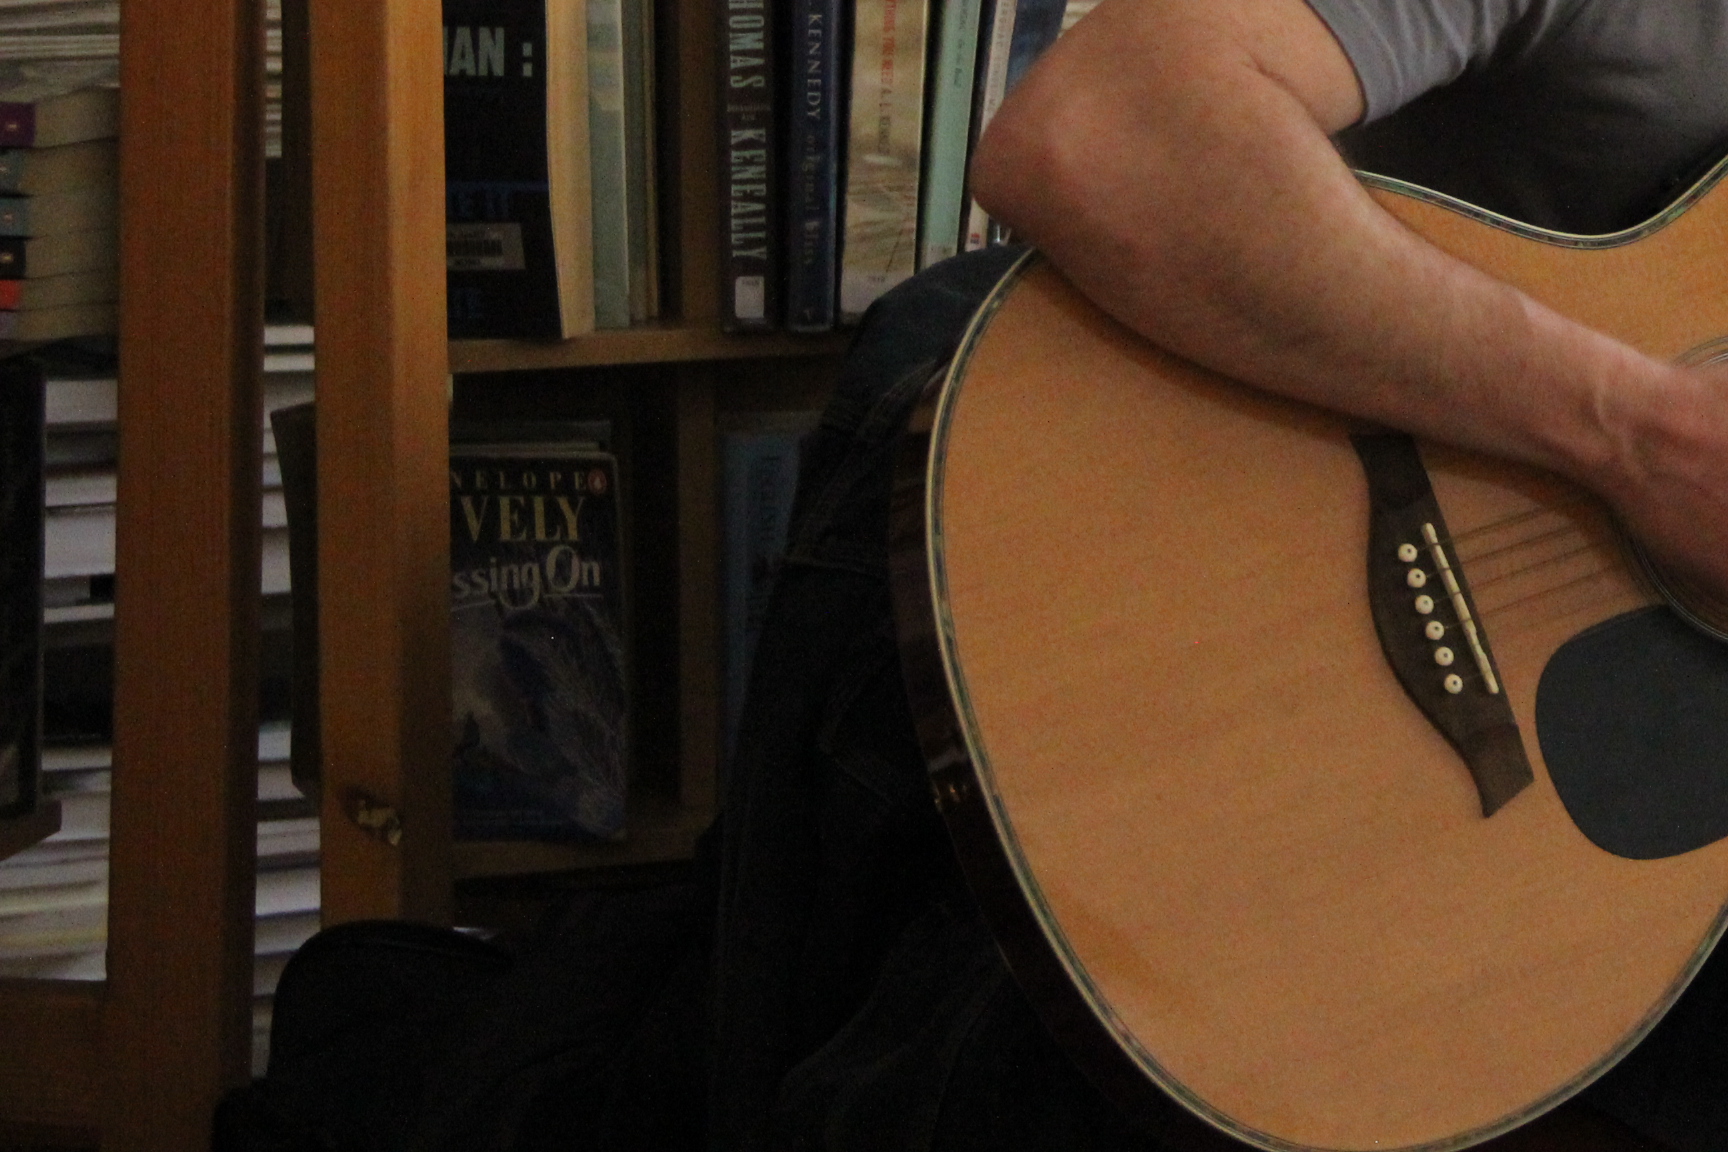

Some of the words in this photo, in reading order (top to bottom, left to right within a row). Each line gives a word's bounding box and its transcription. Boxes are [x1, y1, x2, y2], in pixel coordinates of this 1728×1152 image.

[806, 13, 823, 121] KENNEDY
[730, 128, 767, 261] KENEALLY
[460, 495, 586, 542] VELY
[545, 543, 601, 593] On
